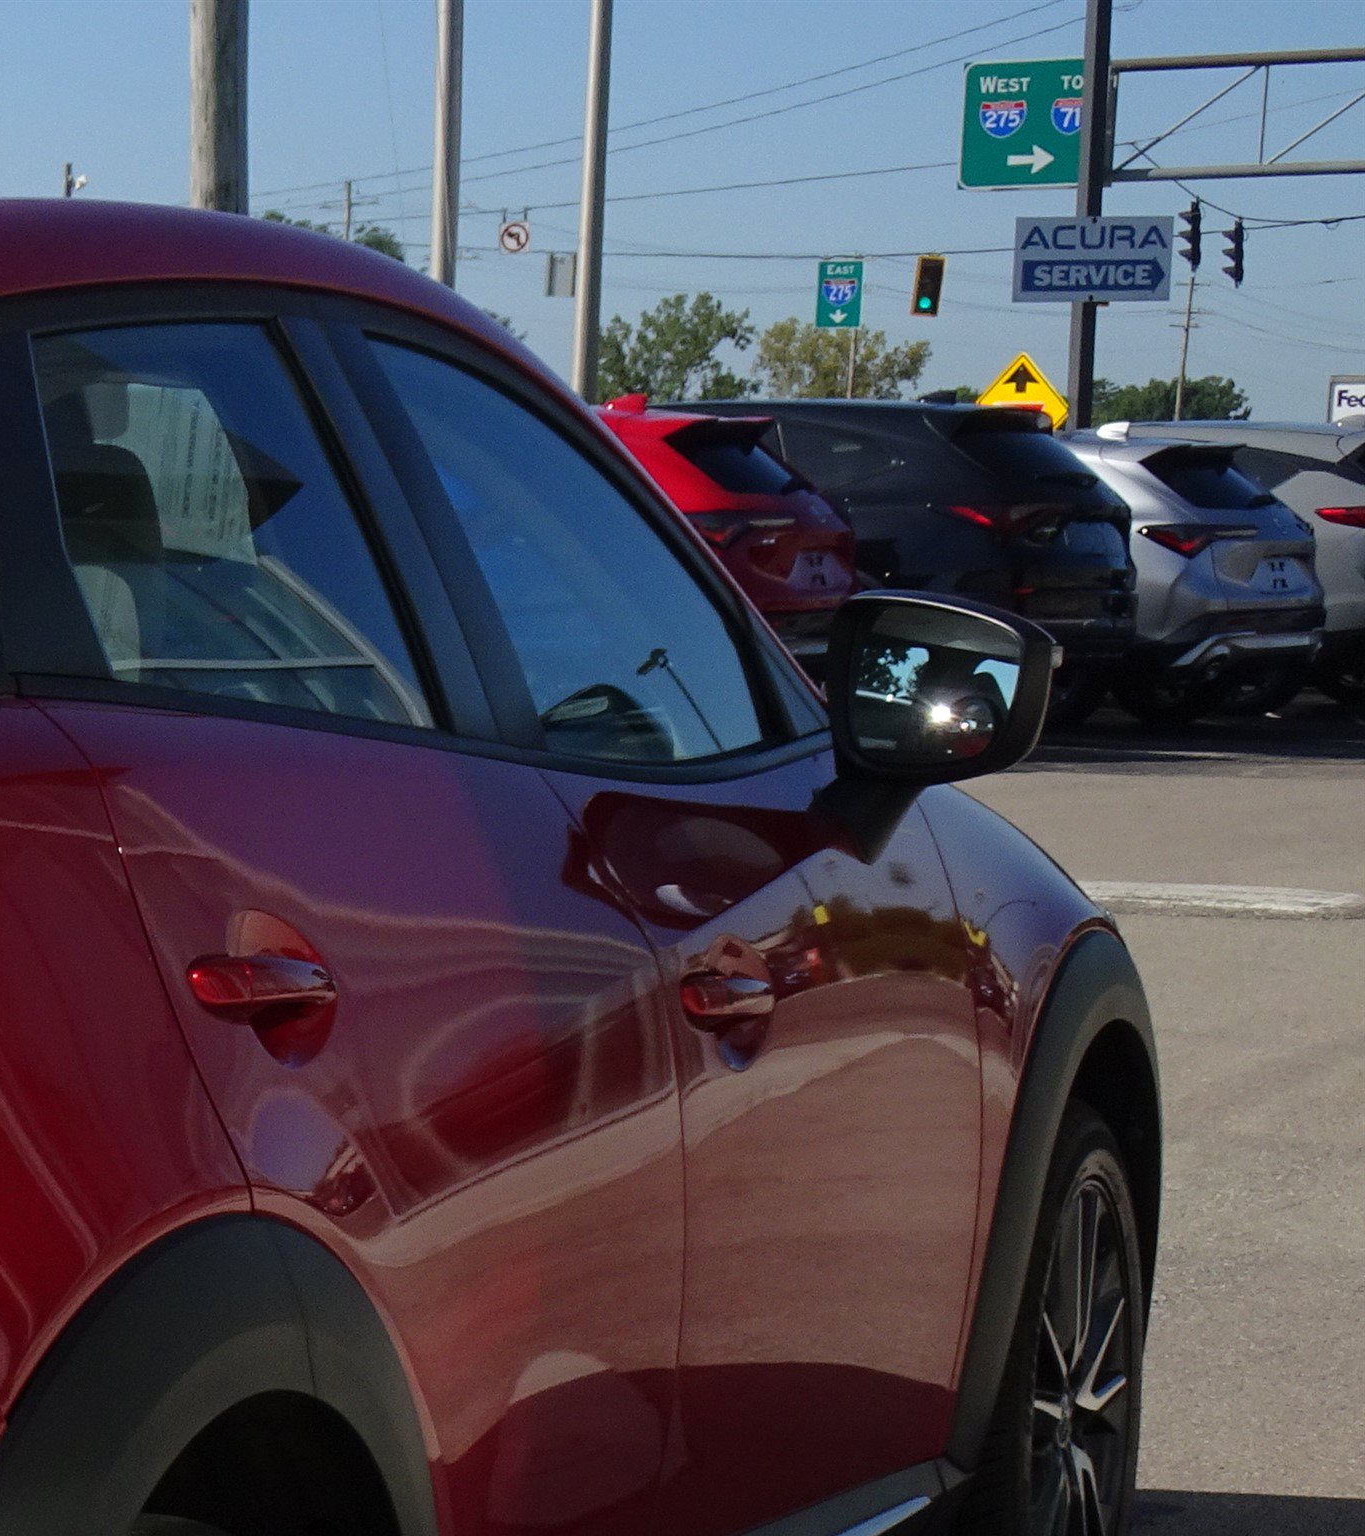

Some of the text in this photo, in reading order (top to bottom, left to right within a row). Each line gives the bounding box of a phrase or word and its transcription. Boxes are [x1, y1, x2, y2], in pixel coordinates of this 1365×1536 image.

[985, 107, 1081, 129] 275 71
[1021, 224, 1168, 250] ACURA
[1033, 264, 1153, 287] SERVICE
[829, 285, 852, 301] 275
